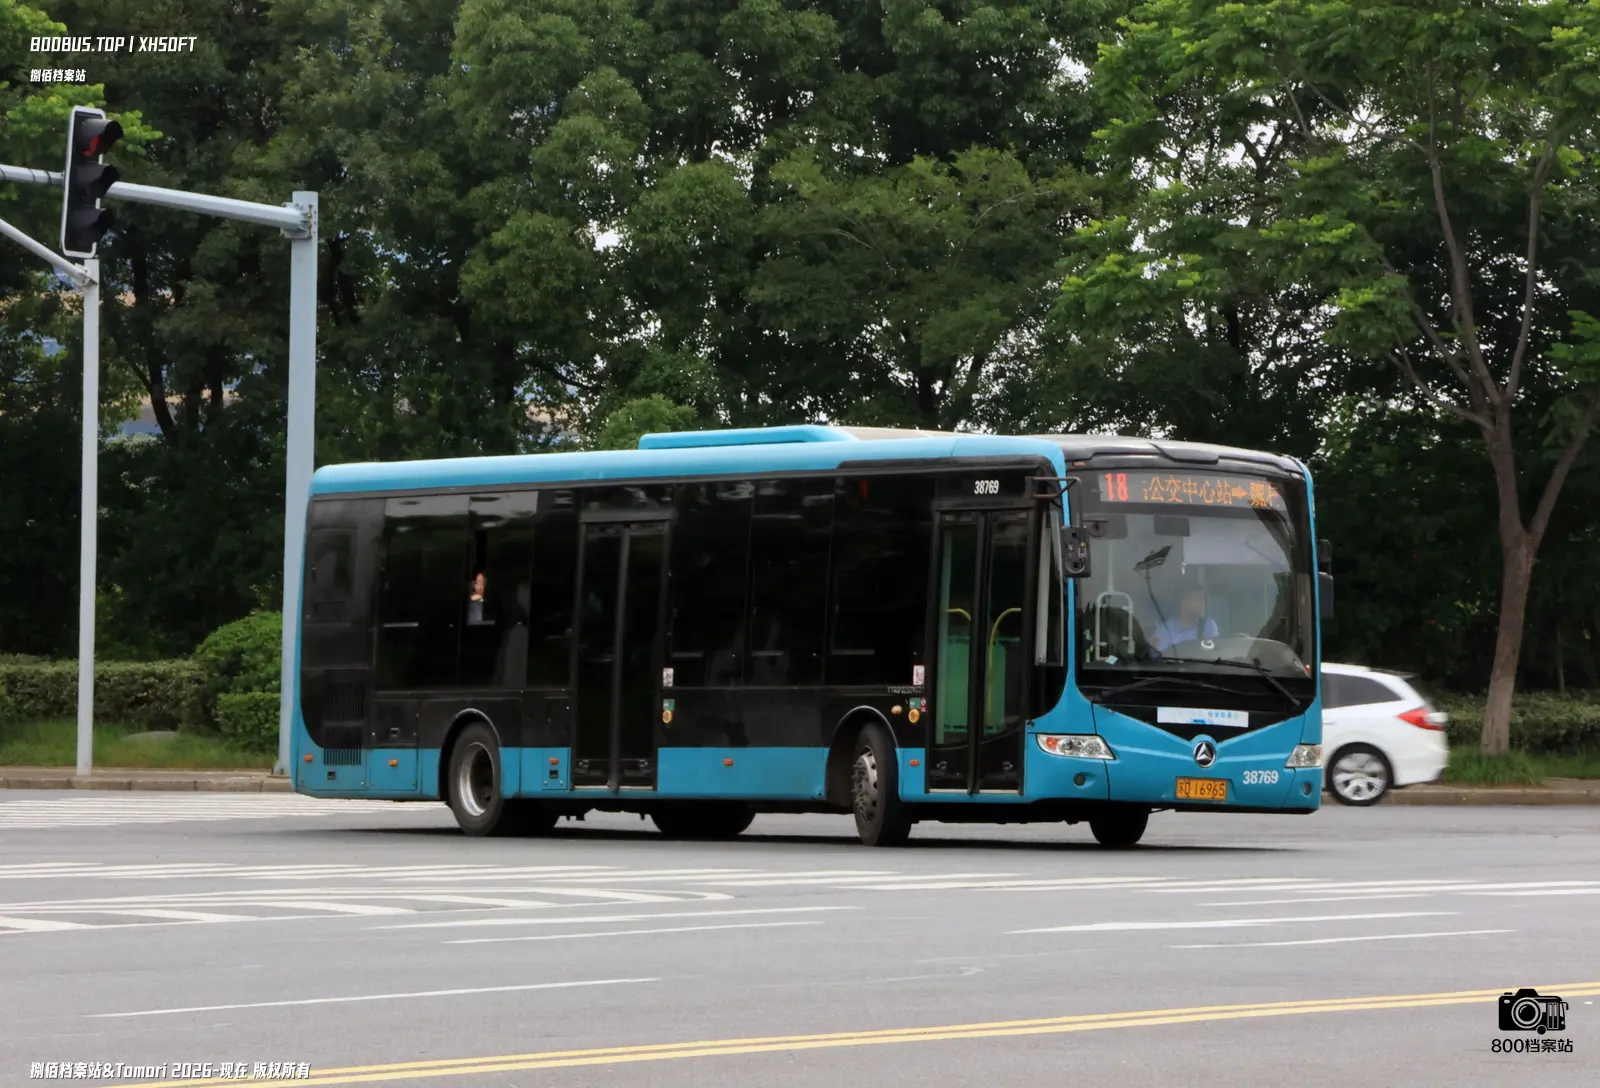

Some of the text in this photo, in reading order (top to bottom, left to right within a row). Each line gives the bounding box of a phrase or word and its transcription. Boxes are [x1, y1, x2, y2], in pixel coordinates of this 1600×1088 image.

[974, 479, 999, 494] 38769
[1105, 473, 1129, 501] 18
[1243, 770, 1279, 785] 38769
